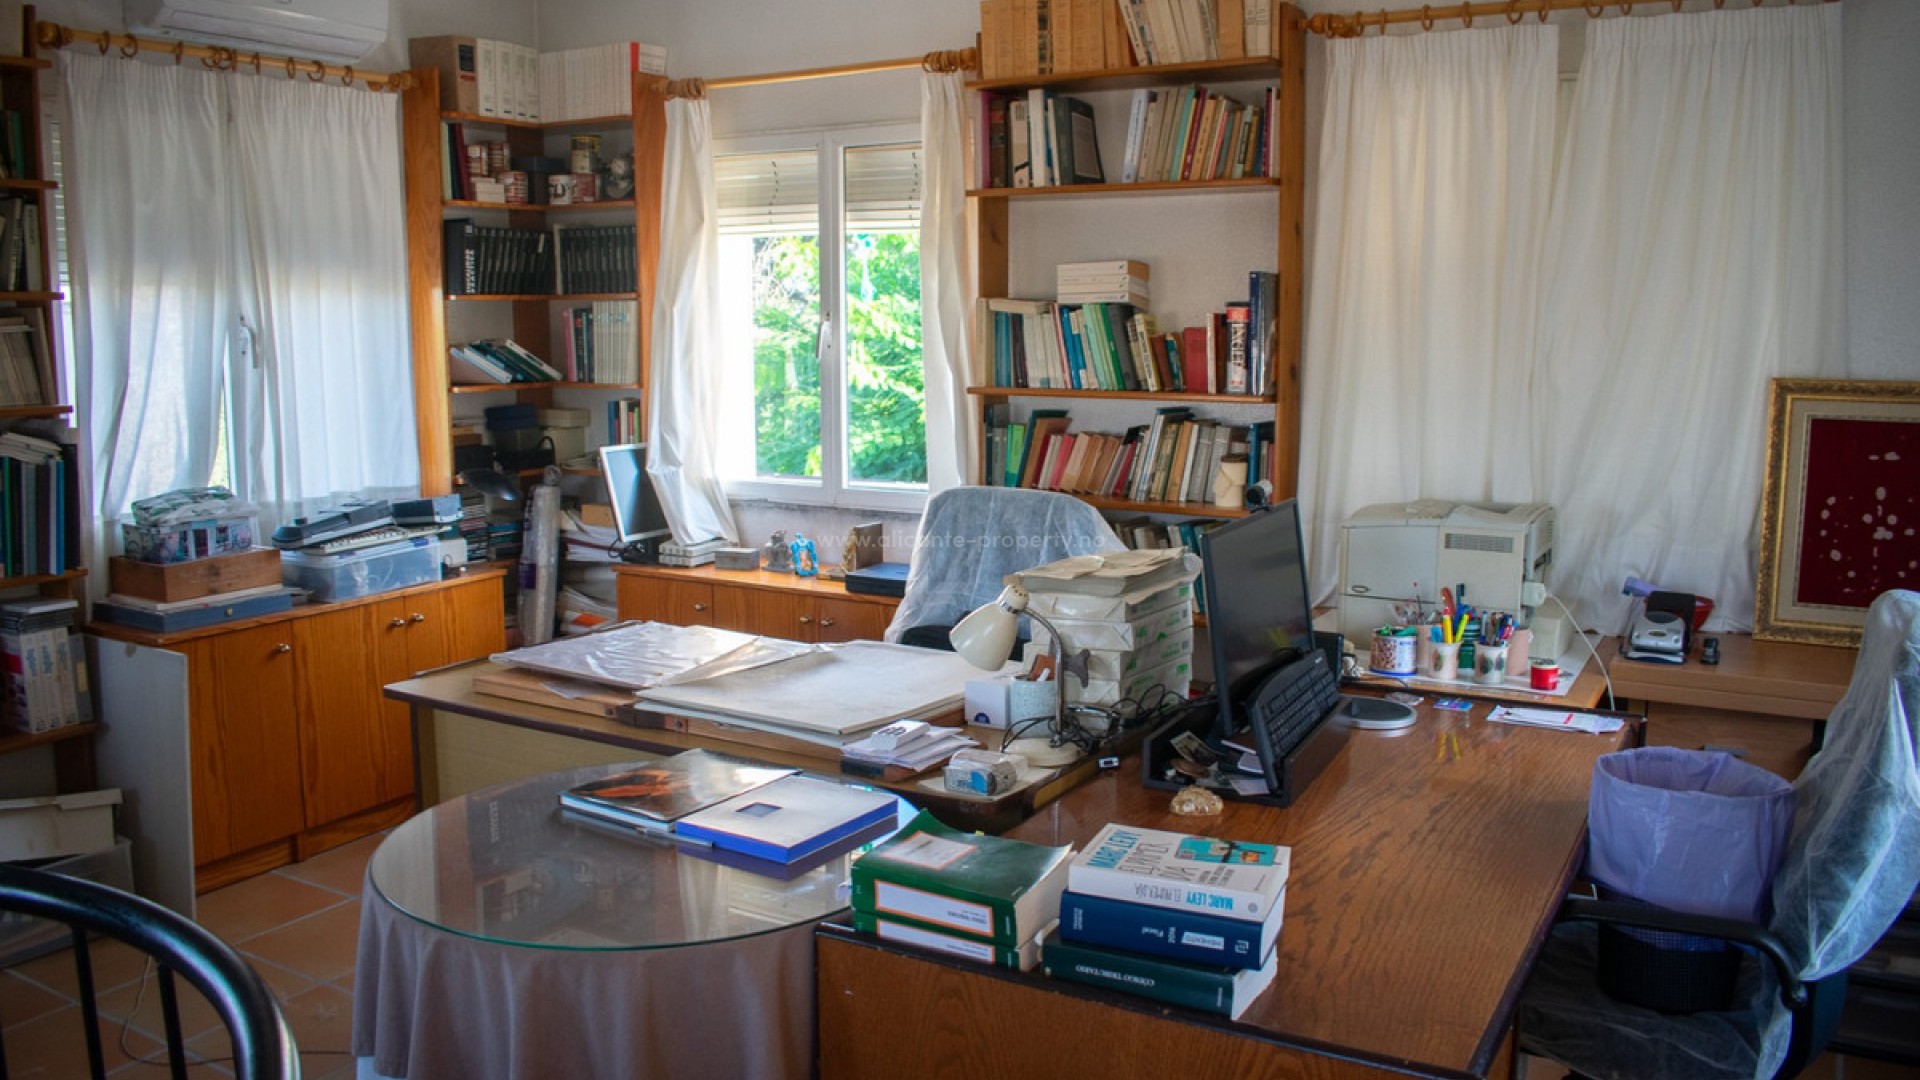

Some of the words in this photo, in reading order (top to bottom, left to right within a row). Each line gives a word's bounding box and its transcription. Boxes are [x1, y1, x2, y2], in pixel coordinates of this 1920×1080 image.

[1104, 829, 1140, 848] LEVY
[1086, 846, 1128, 868] MARC
[1186, 891, 1207, 906] LEVY
[1208, 894, 1234, 910] MARC
